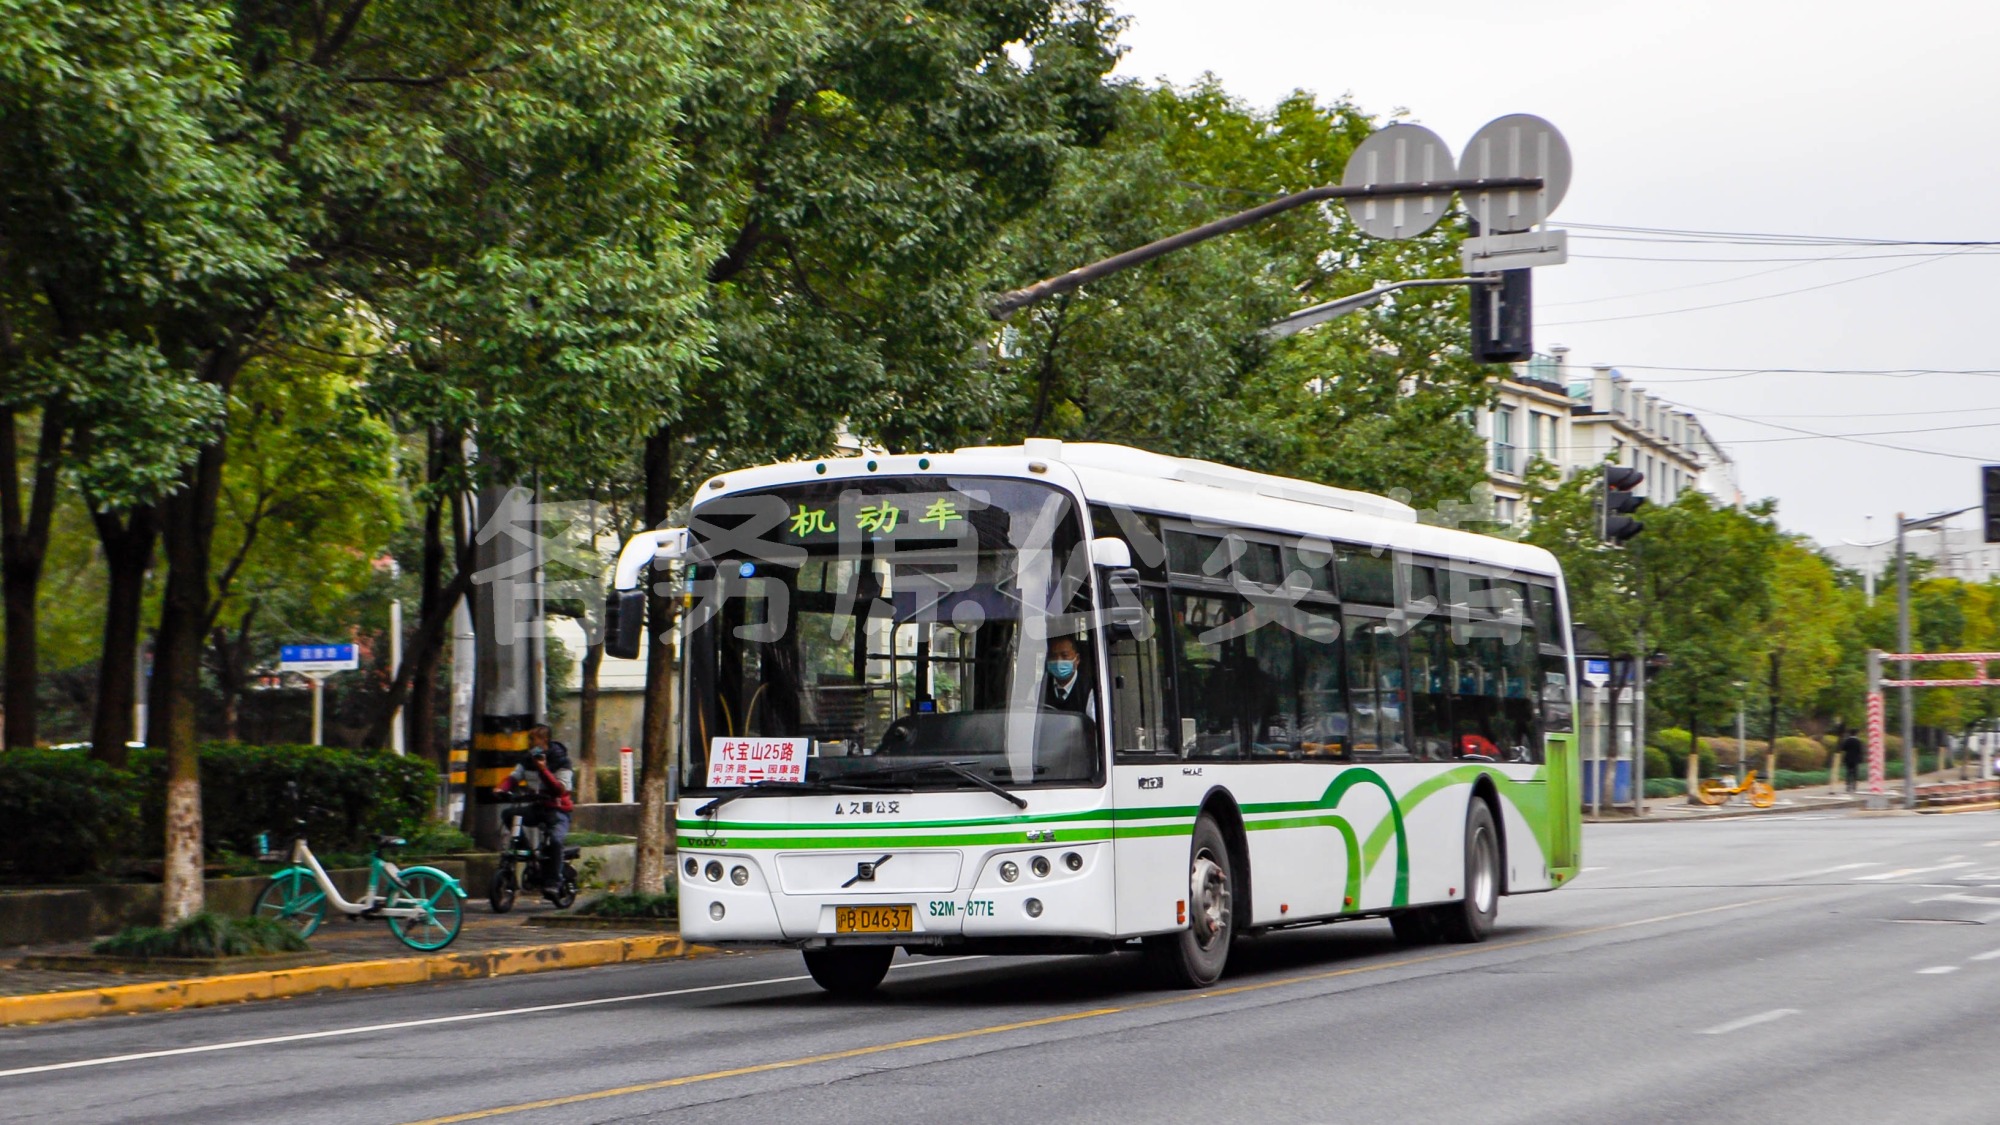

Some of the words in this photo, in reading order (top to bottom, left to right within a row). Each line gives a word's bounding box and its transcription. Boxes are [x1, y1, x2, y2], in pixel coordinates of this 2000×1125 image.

[789, 497, 963, 537] 机动车
[722, 741, 794, 761] 代宝山25路
[713, 763, 747, 774] 同济路
